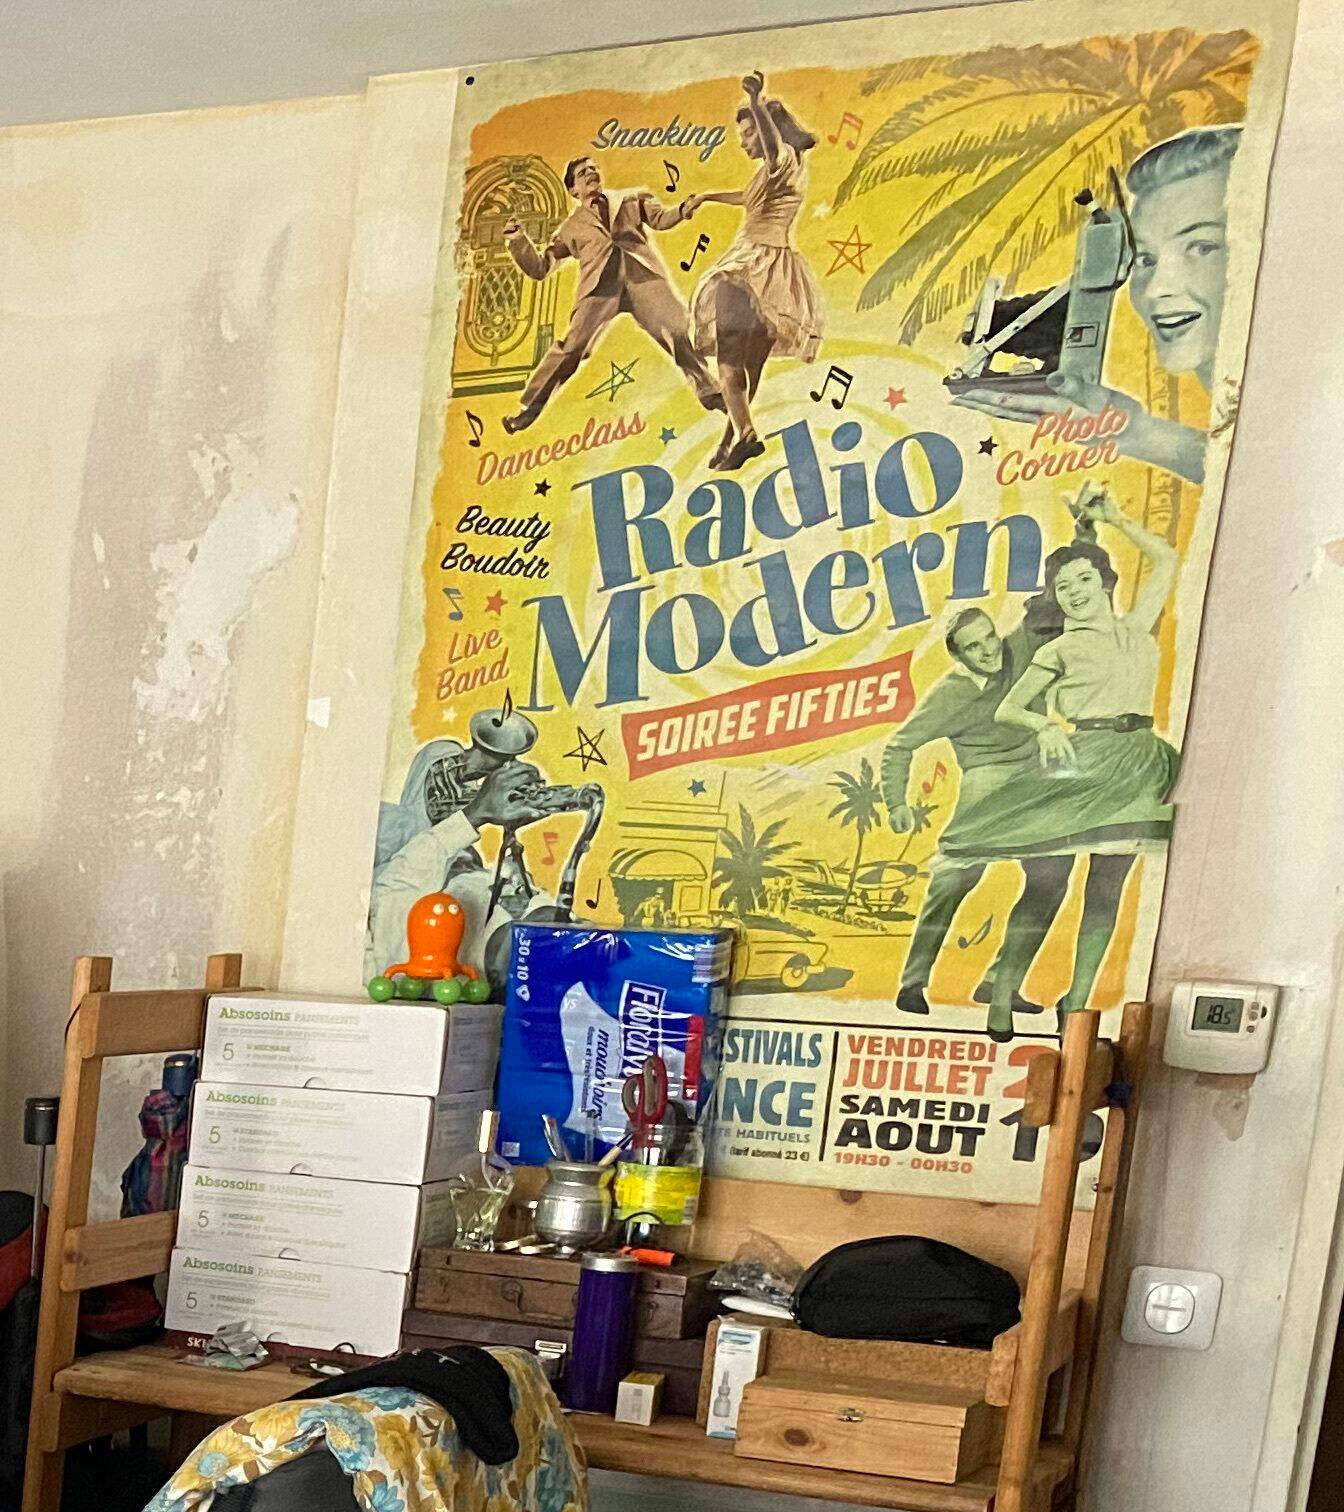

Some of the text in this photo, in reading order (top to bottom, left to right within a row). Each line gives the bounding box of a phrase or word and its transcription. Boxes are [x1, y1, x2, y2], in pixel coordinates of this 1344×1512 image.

[591, 117, 727, 162] Snacking
[477, 410, 647, 486] Danceclass
[1033, 410, 1130, 450] Photo
[996, 437, 1120, 487] Corner
[572, 419, 963, 592] Radio
[456, 505, 552, 552] Beauty
[441, 544, 551, 580] Boudoir
[517, 510, 1047, 711] Modern
[449, 627, 502, 666] Live
[436, 658, 510, 701] Band
[636, 672, 901, 763] SOIREE FIFTIES
[219, 1006, 291, 1022] Absosoins
[624, 986, 660, 1078] Floraly
[222, 1042, 234, 1061] 5
[725, 1028, 822, 1068] STIVALS
[848, 1034, 998, 1063] VENDREDI
[843, 1059, 993, 1097] JUILLET
[206, 1090, 277, 1106] Absosoins
[721, 1077, 816, 1128] NCE
[839, 1095, 990, 1124] SAMEDI
[208, 1126, 221, 1144] 5
[736, 1129, 810, 1144] HABITUELS
[834, 1119, 986, 1157] AOUT
[834, 1151, 891, 1168] 19H30
[911, 1157, 973, 1174] 00H30
[195, 1175, 266, 1192] Absosoins
[197, 1210, 209, 1228] 5
[183, 1256, 255, 1275] Absosoins
[185, 1291, 198, 1310] 5
[187, 1336, 206, 1348] SKI
